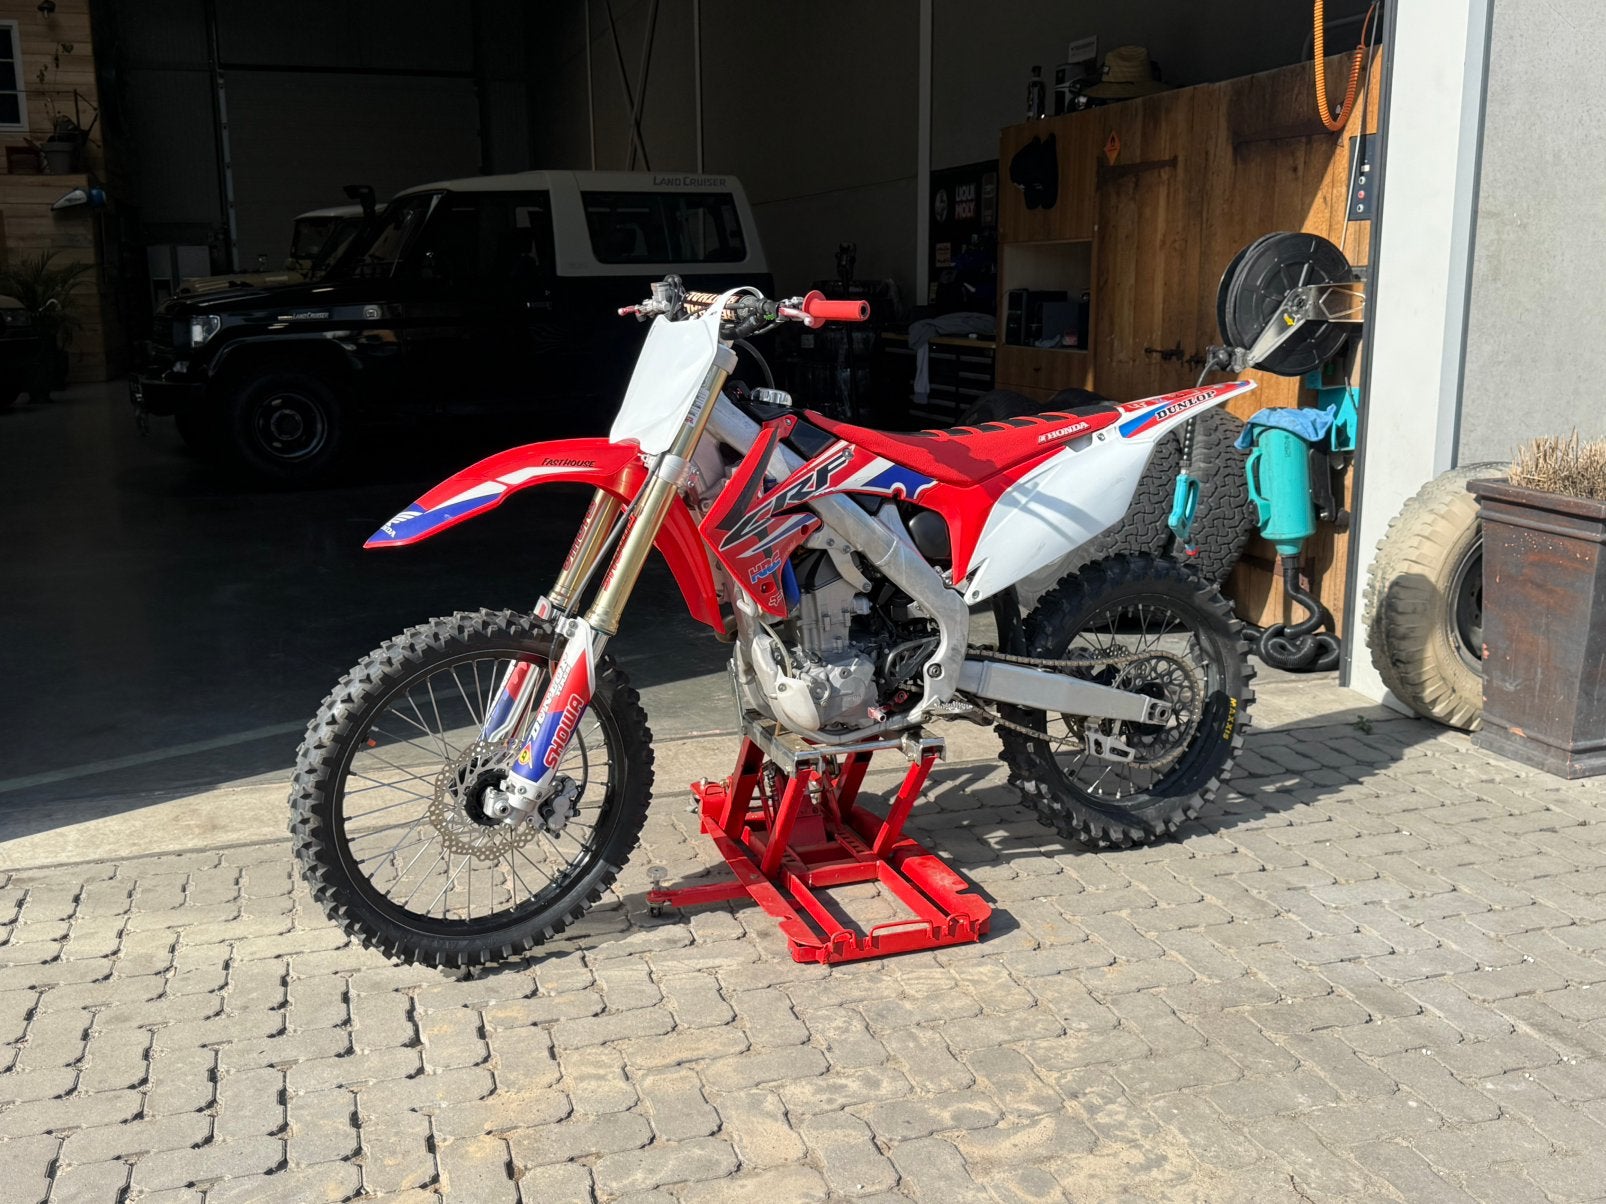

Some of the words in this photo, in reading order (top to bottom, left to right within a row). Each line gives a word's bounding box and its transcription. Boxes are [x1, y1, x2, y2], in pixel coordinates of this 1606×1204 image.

[653, 176, 682, 186] LAND
[683, 176, 727, 187] CRUISER
[956, 184, 976, 201] LIQUI
[955, 201, 976, 219] MOLY
[1155, 390, 1217, 420] DUNLOP
[1046, 421, 1090, 441] HONDA
[541, 457, 596, 468] FASTHOUSE
[748, 551, 782, 584] HRC
[1222, 697, 1237, 740] MAXXIS
[543, 693, 585, 770] SHOWA
